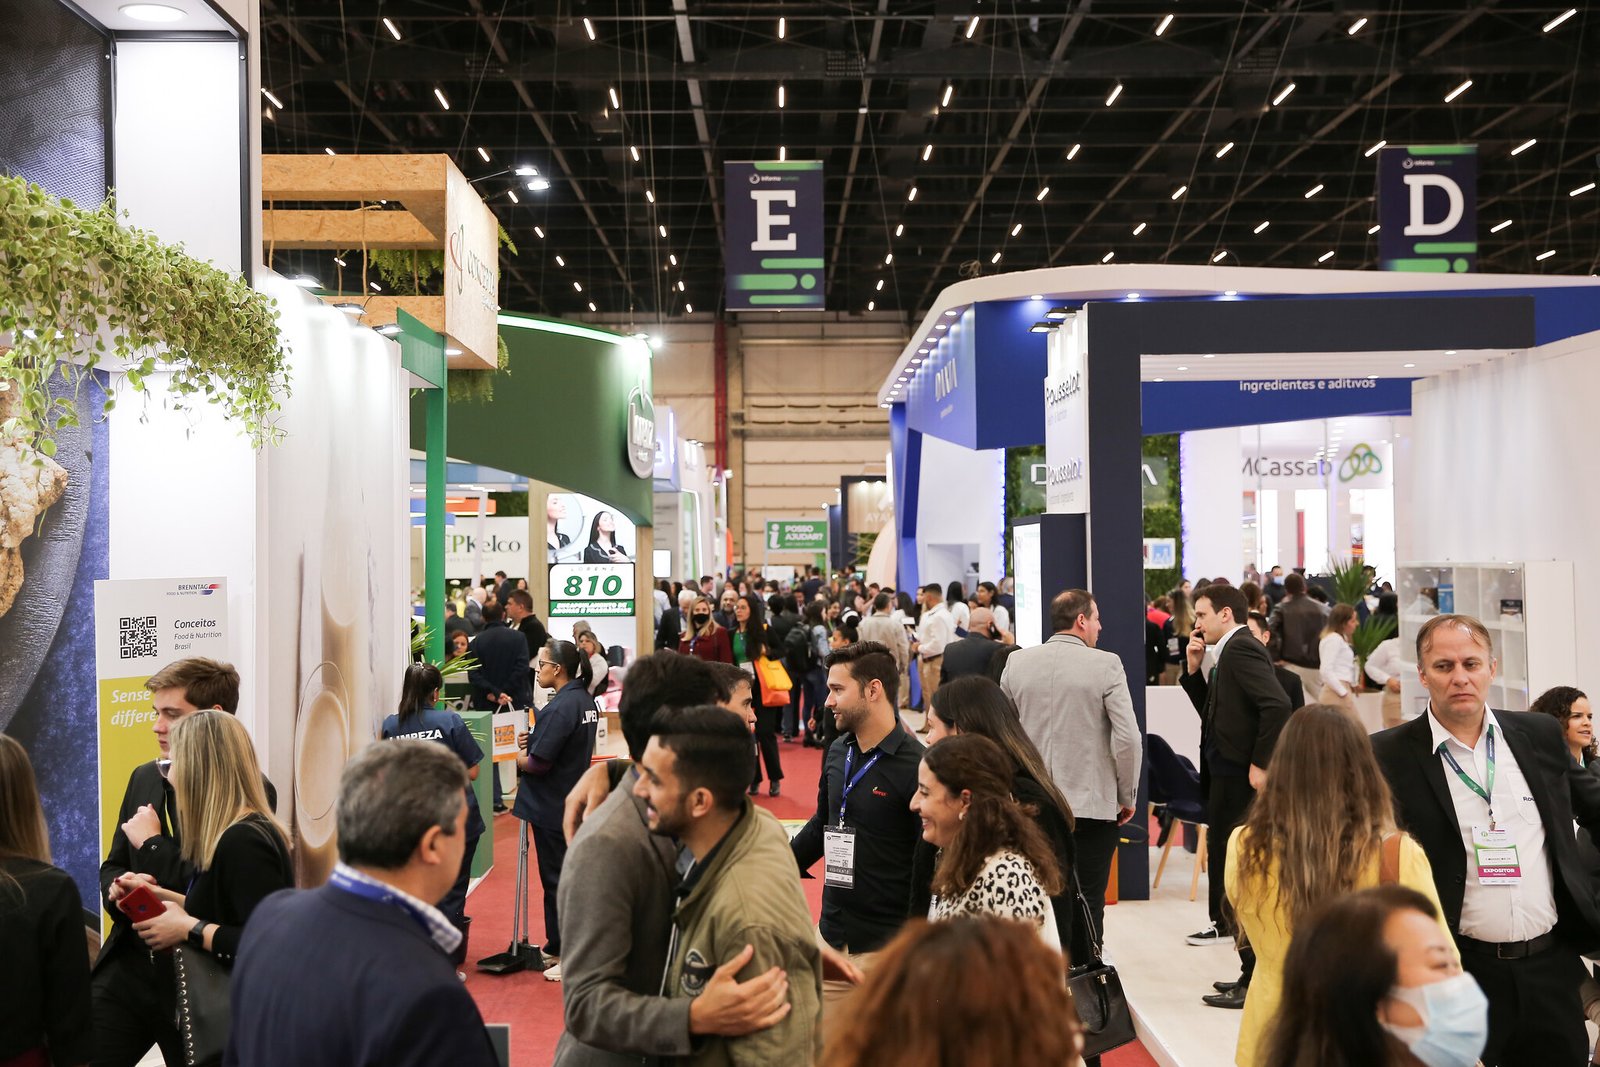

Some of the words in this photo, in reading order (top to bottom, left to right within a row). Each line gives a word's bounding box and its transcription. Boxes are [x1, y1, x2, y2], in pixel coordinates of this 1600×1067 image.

[1403, 174, 1465, 236] D
[750, 190, 797, 251] E
[1318, 380, 1325, 390] e
[1328, 379, 1376, 390] aditivos
[785, 525, 814, 533] POSSO
[564, 575, 622, 596] 810
[174, 618, 216, 628] Conceitos
[111, 689, 152, 703] Sense
[111, 709, 157, 727] differe
